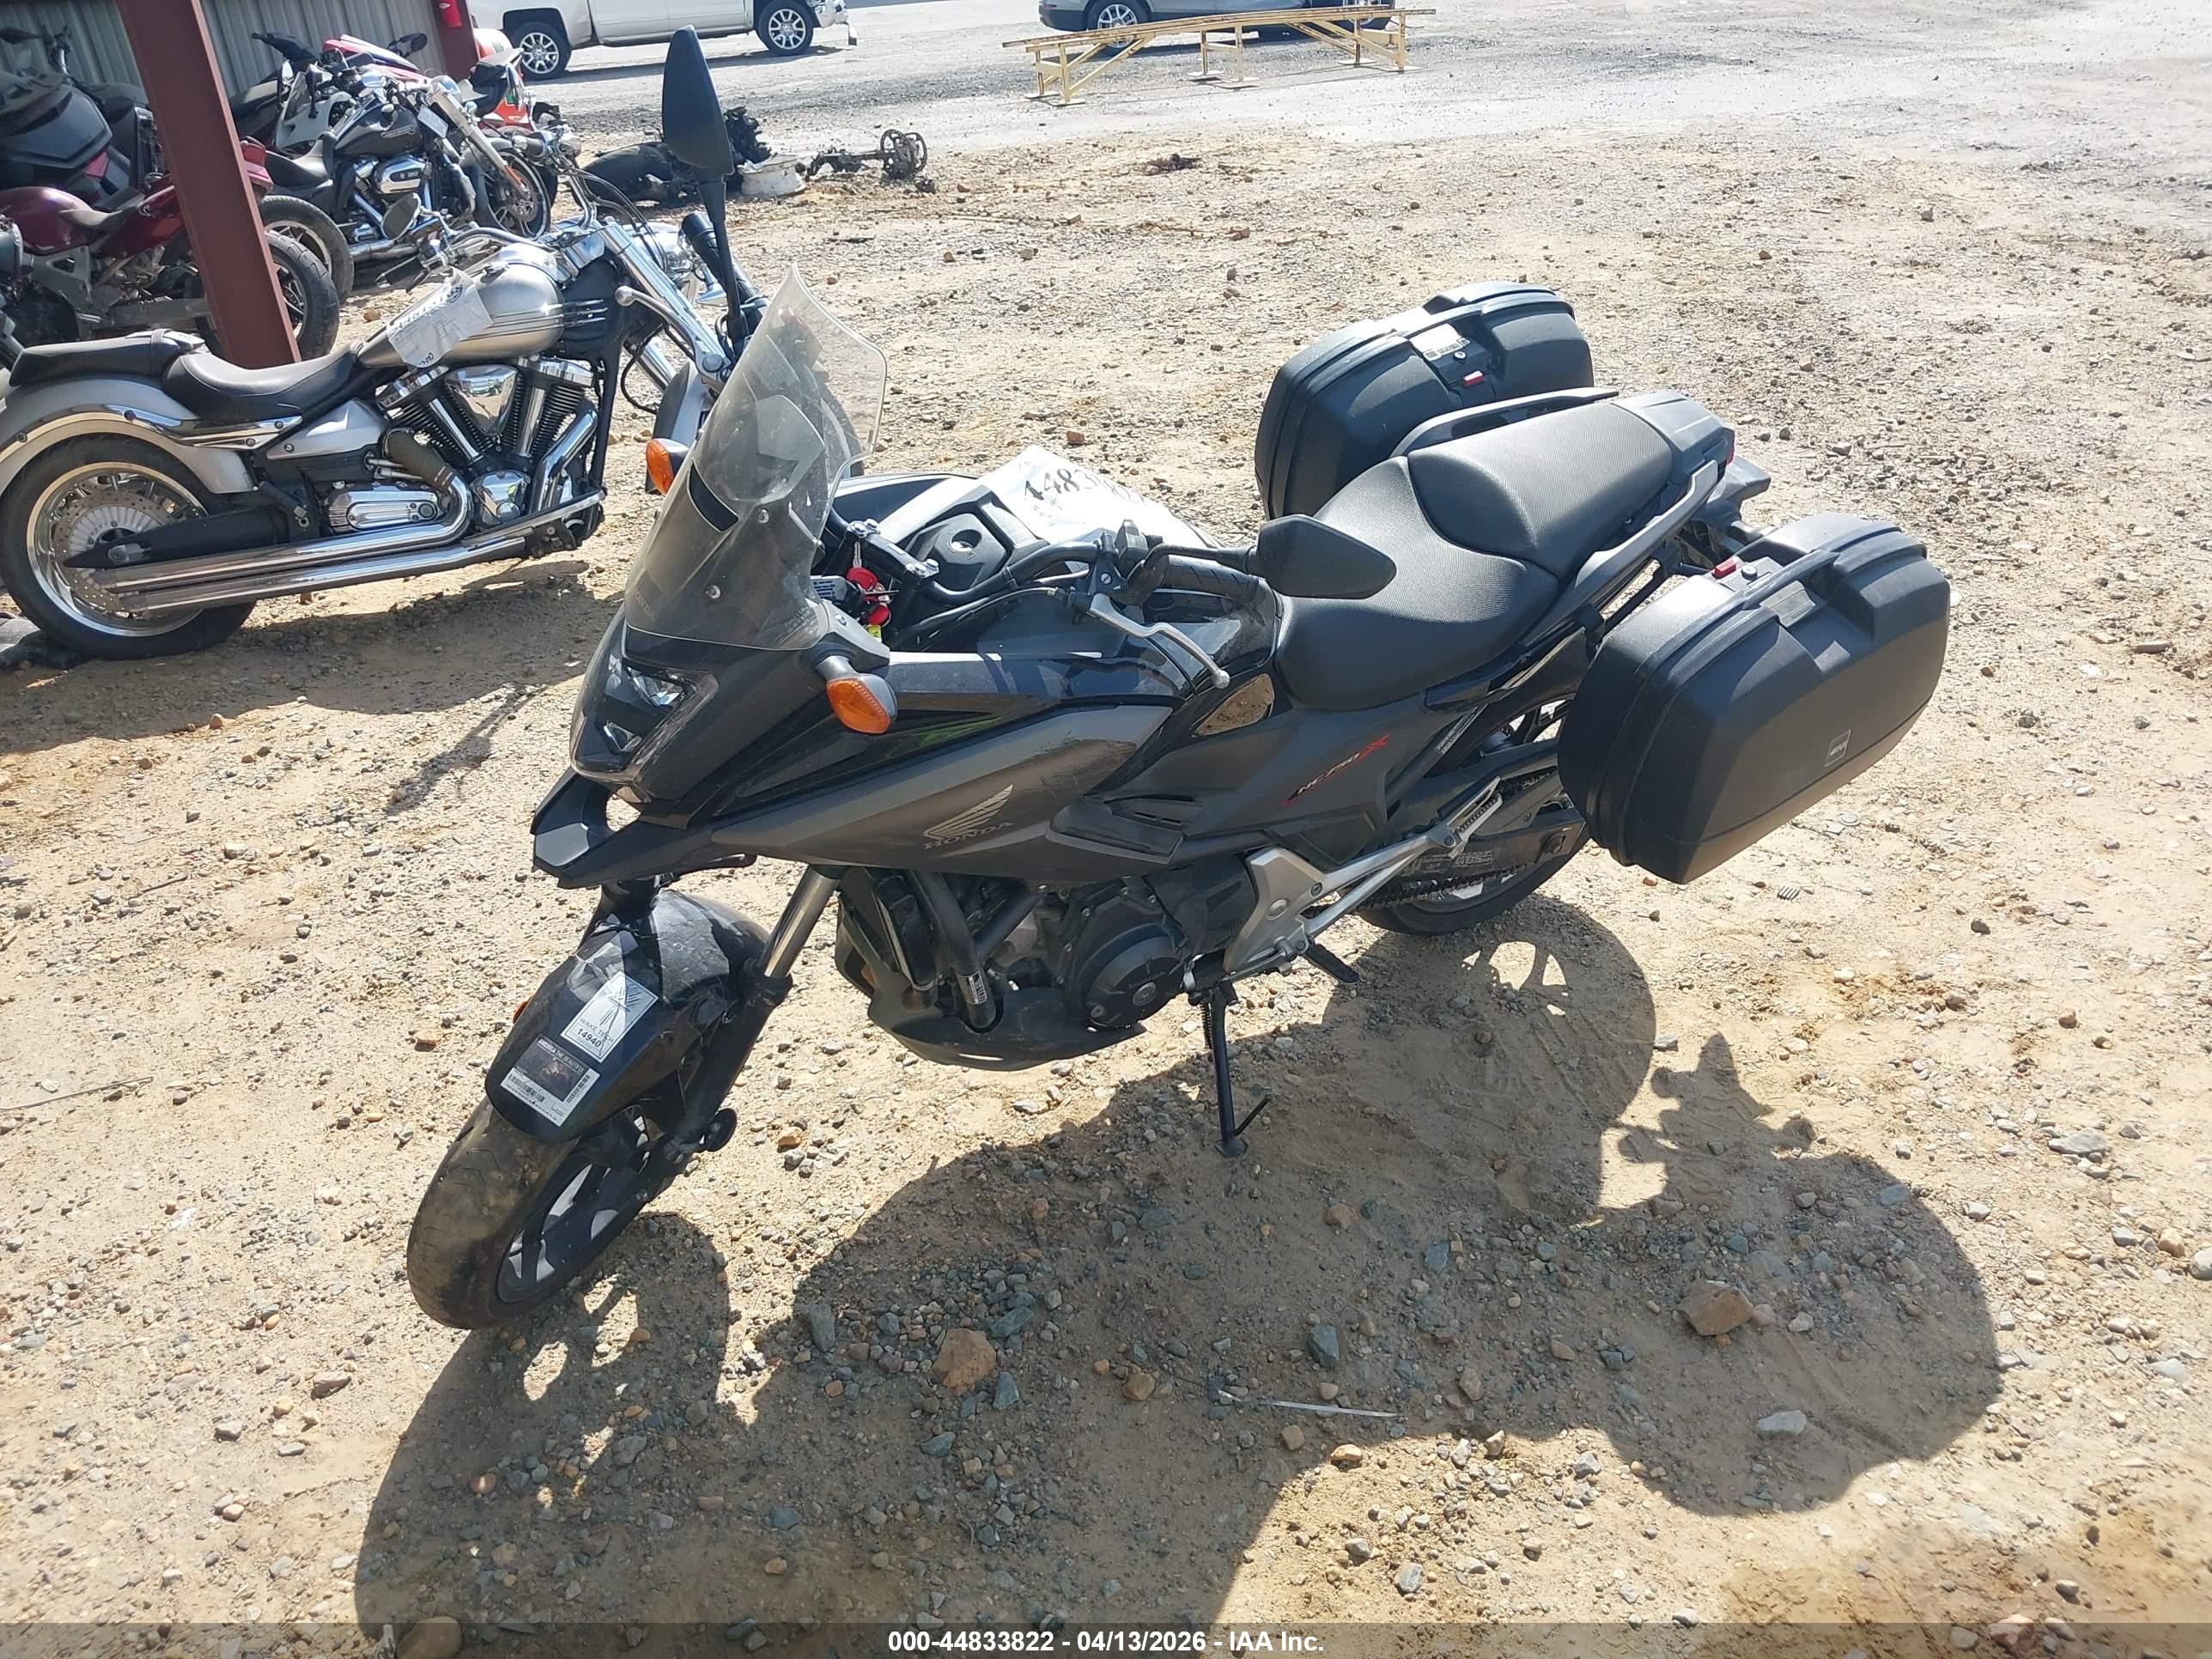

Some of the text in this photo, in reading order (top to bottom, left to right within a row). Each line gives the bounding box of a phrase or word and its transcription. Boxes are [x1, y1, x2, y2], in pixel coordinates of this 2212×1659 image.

[922, 821, 1014, 850] HONDA
[577, 1027, 602, 1048] 14940
[580, 1017, 615, 1043] WAKE TECH
[555, 1050, 564, 1059] THE
